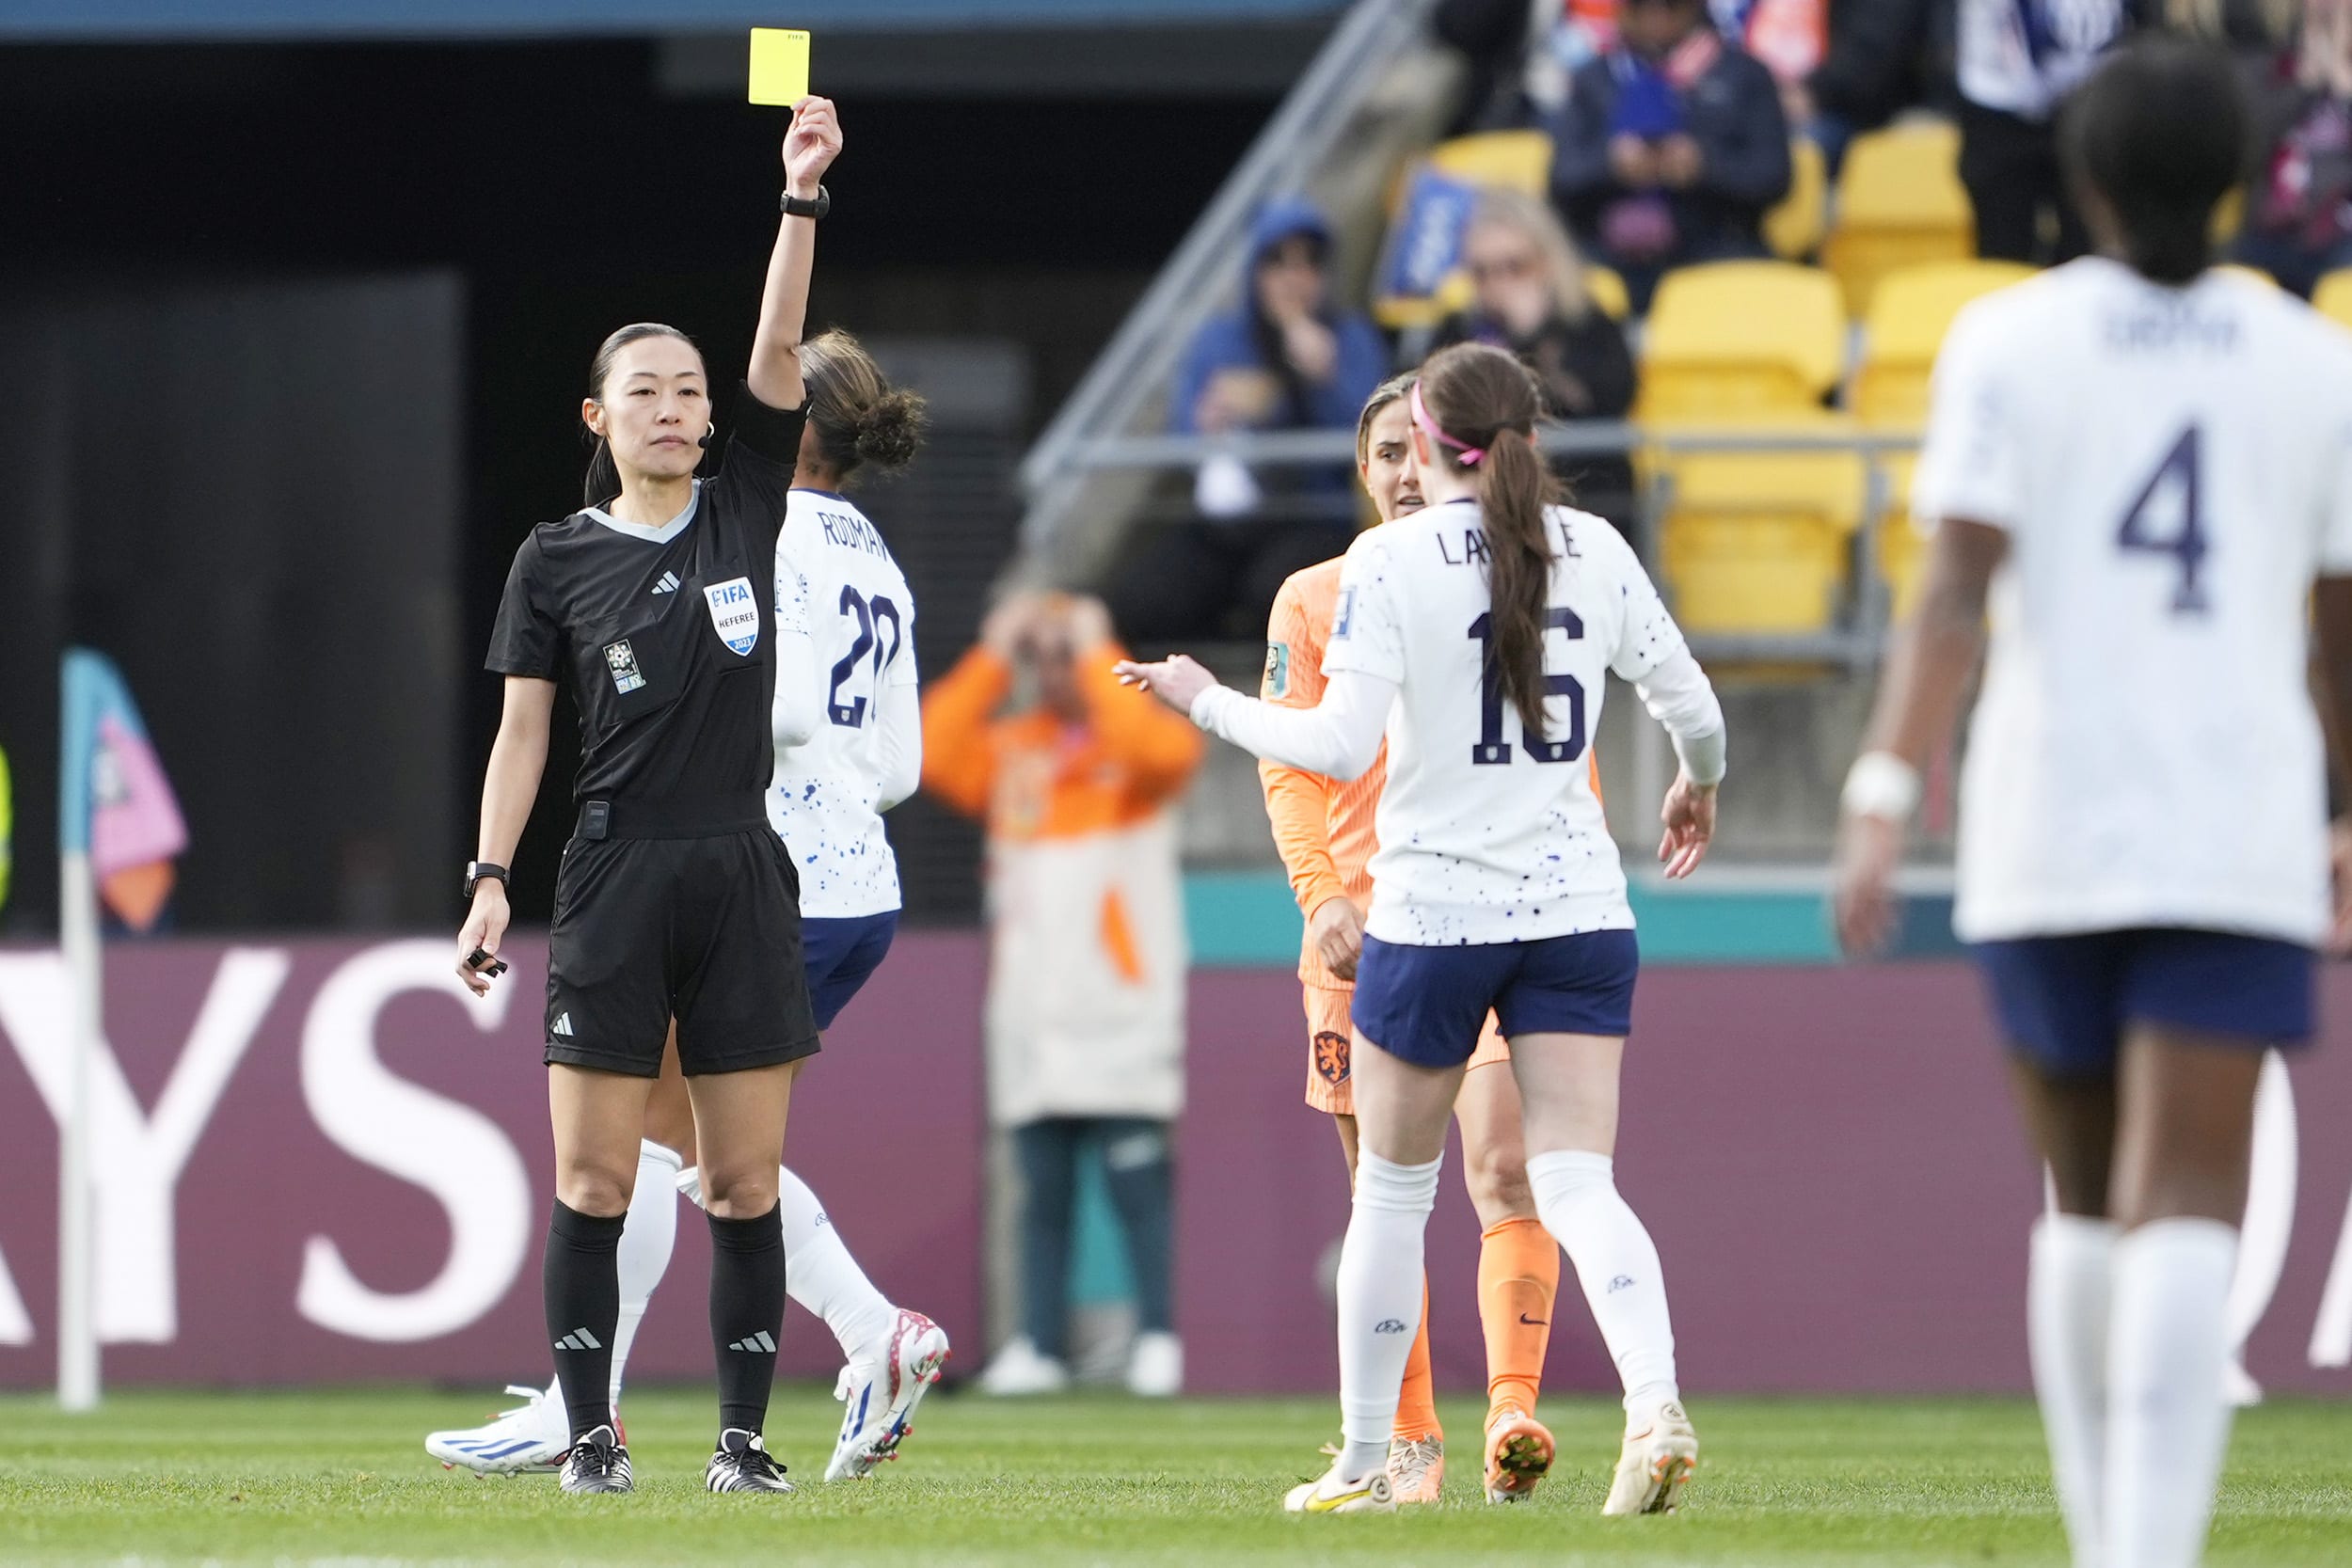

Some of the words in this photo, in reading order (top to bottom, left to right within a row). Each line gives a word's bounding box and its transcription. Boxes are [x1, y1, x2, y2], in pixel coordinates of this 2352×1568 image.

[2117, 423, 2209, 611] 4
[711, 584, 750, 608] FIFA
[718, 611, 755, 628] REFEREE
[827, 584, 900, 729] 20
[1468, 607, 1587, 765] 16
[0, 941, 532, 1344] YS
